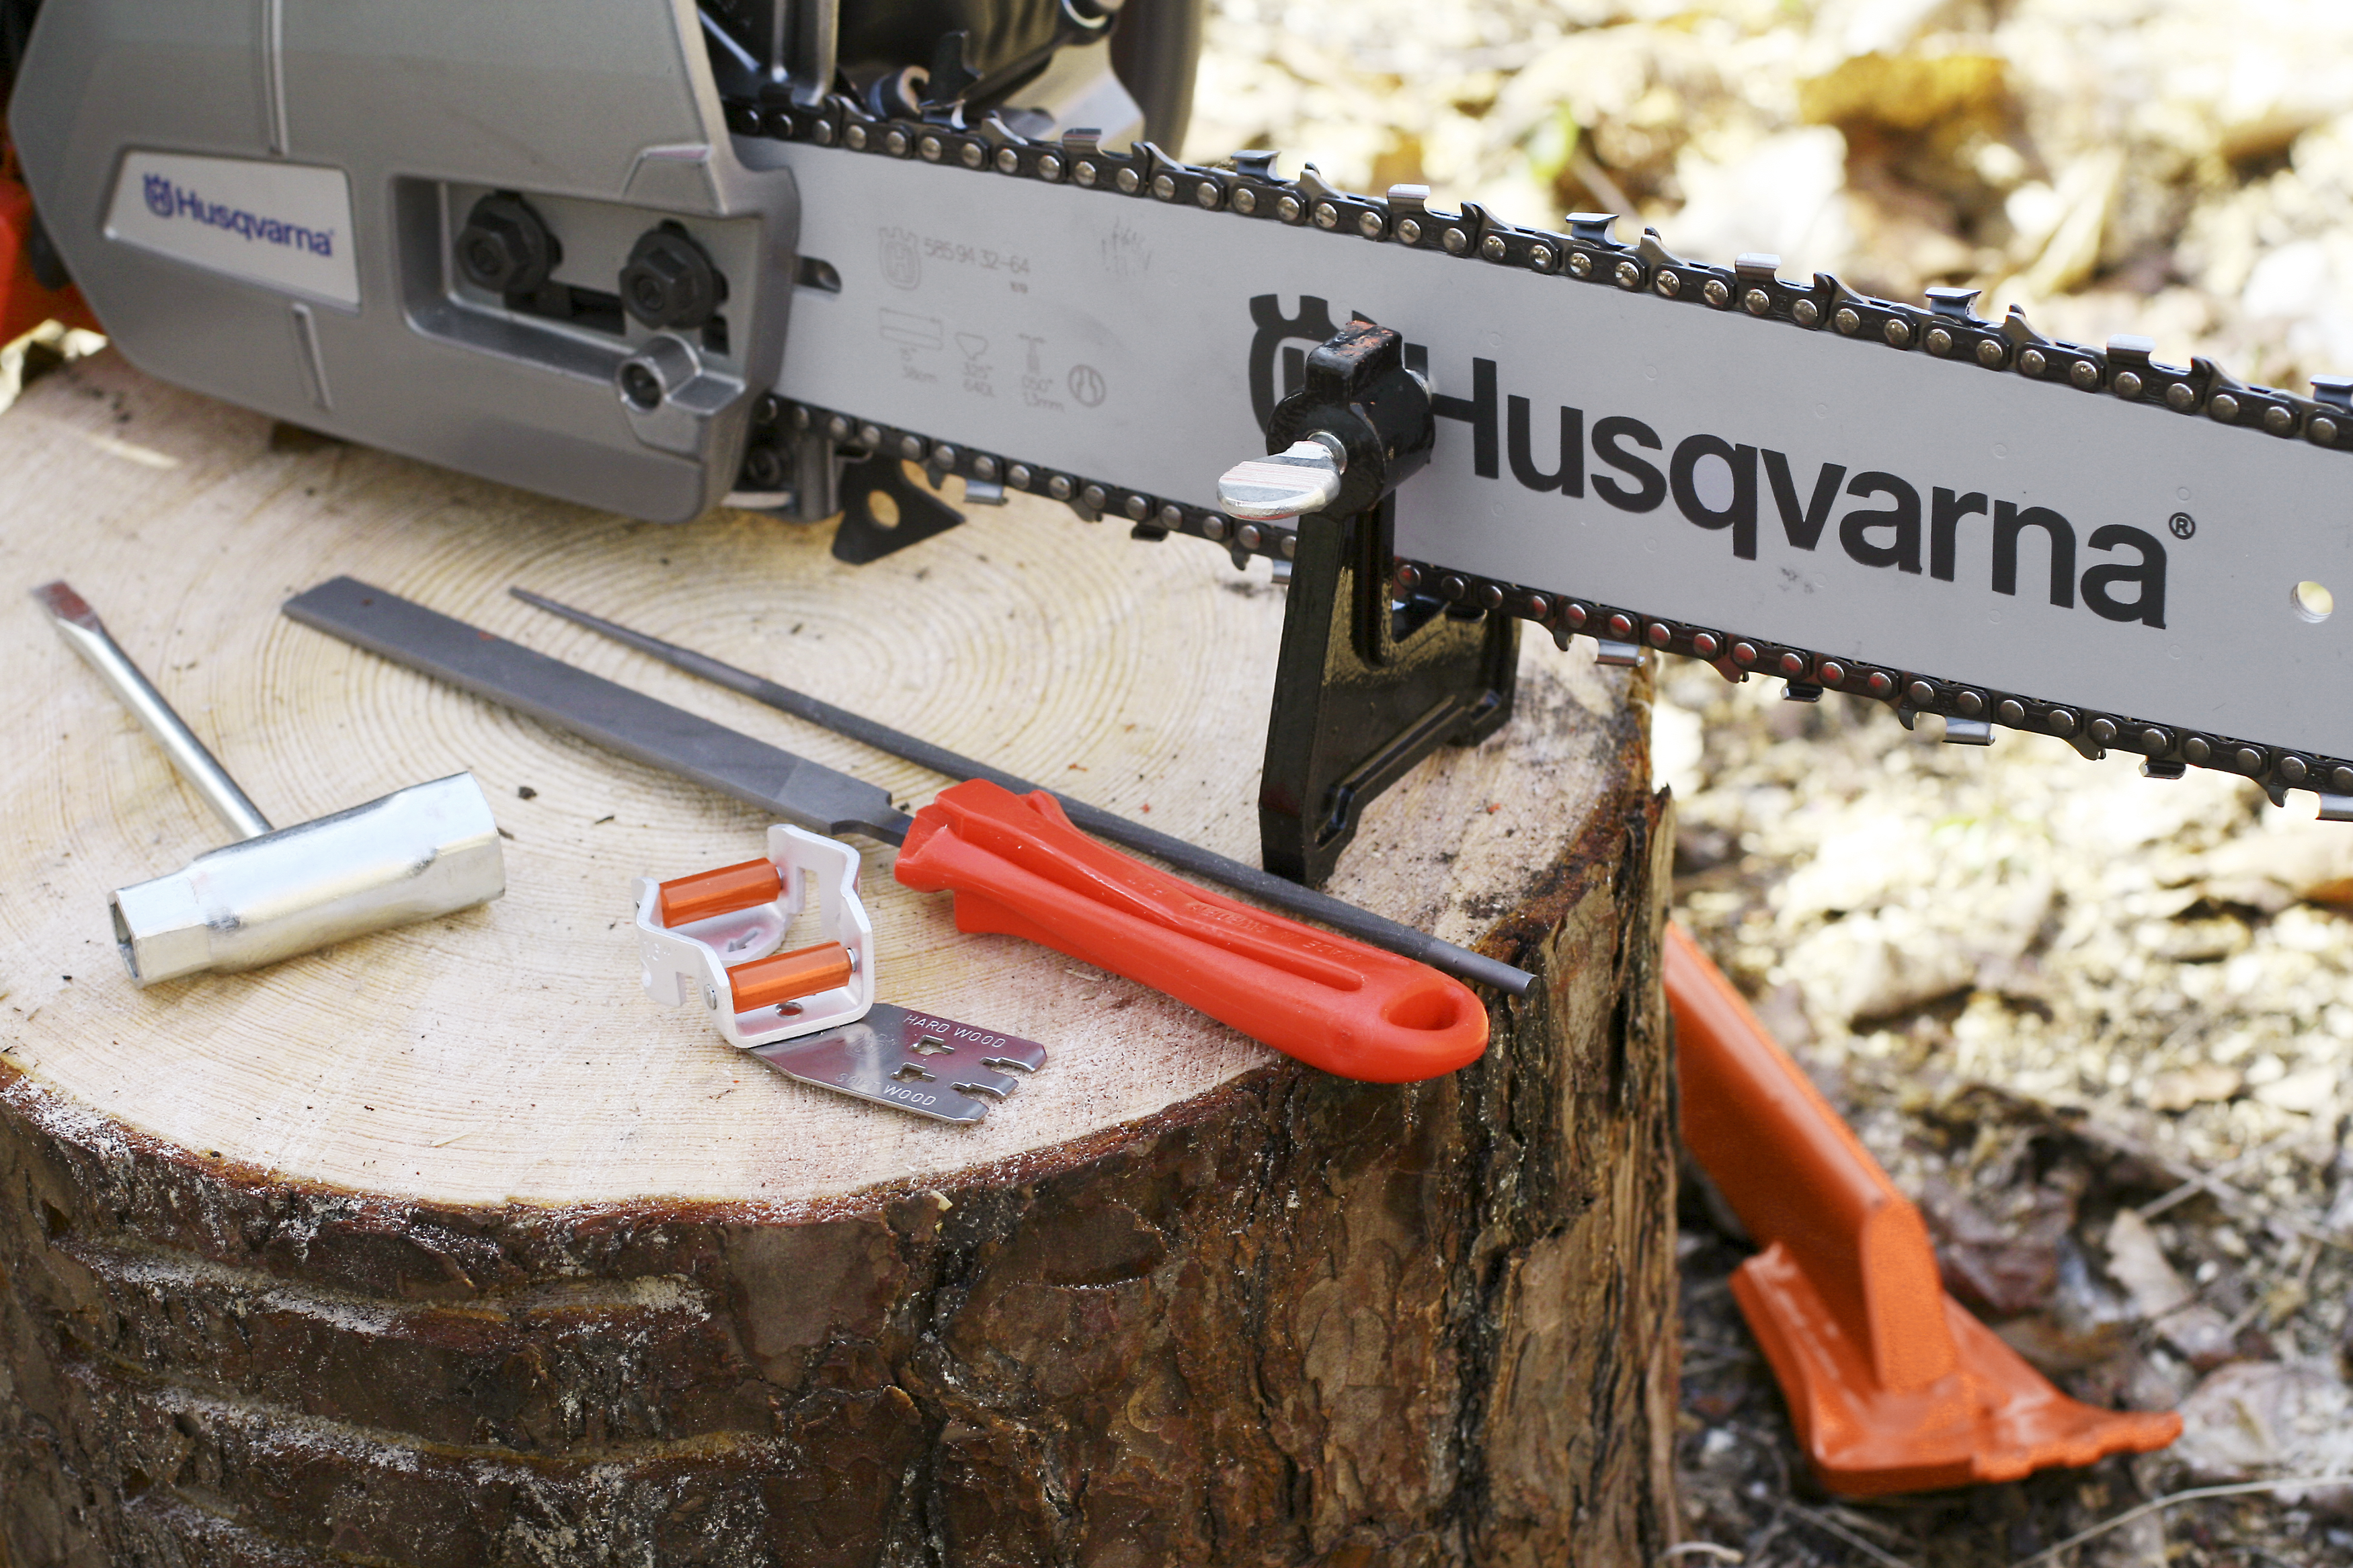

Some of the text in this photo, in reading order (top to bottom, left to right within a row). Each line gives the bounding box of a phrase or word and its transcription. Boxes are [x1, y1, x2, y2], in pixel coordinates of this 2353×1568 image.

[175, 187, 333, 257] Husqvarna
[903, 1014, 1006, 1048] HARD WOOD
[883, 1084, 937, 1106] WOOD
